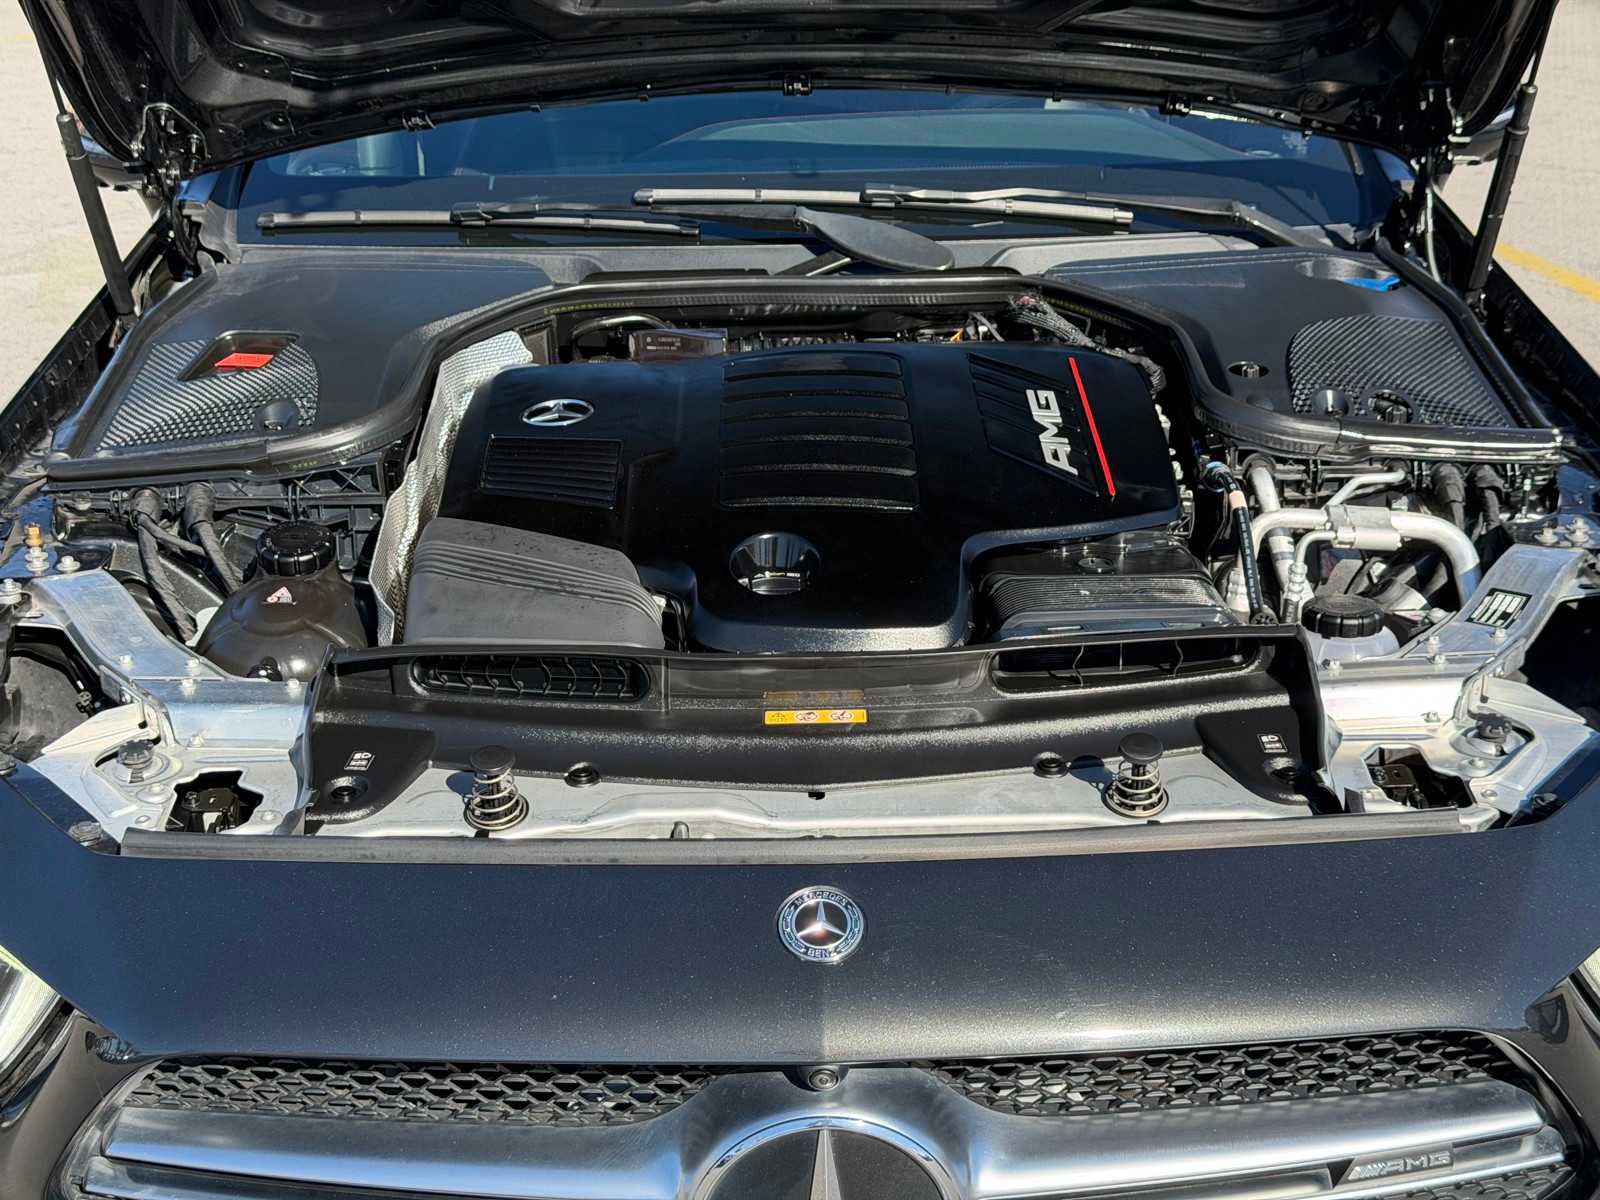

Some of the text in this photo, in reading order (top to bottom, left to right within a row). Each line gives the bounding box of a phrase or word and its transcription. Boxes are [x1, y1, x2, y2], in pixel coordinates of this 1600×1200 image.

[1026, 389, 1079, 475] AMG
[794, 891, 848, 906] MERCEDES
[807, 947, 837, 958] BENZ
[1379, 1150, 1451, 1176] AMG
